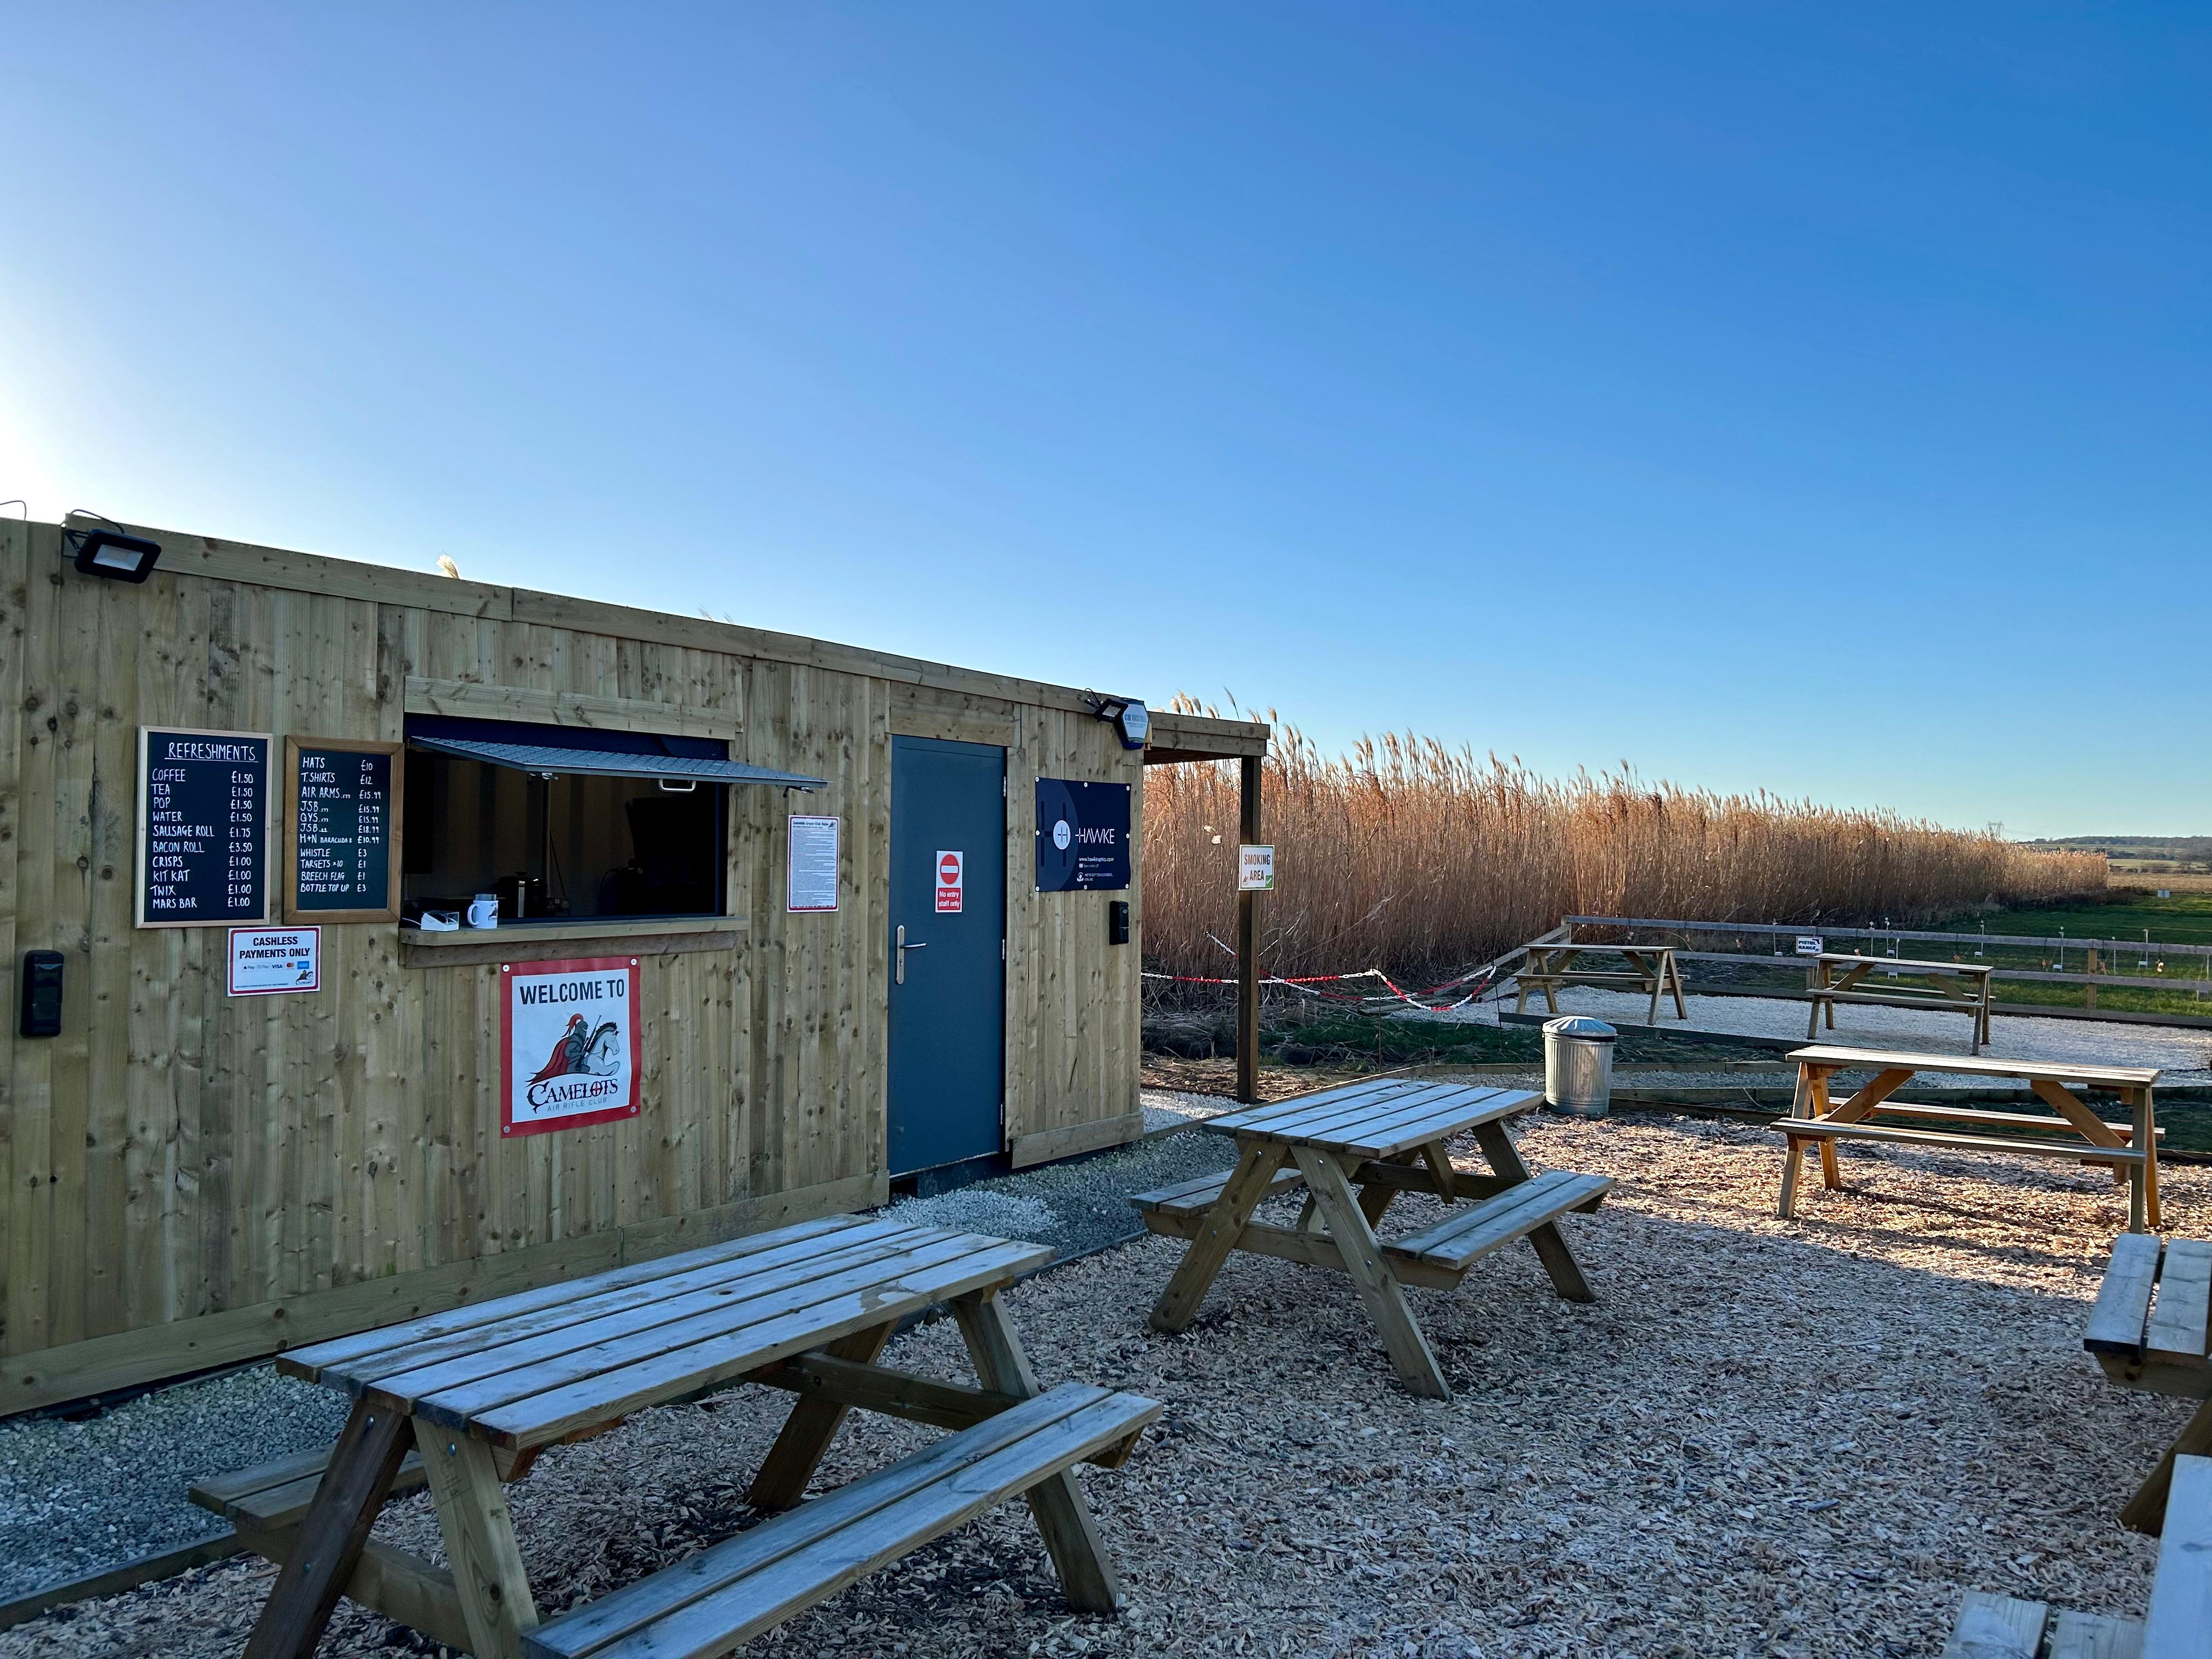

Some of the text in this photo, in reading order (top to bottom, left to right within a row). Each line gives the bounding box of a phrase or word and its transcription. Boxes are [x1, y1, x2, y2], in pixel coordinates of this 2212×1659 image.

[168, 742, 256, 761] REFRESHMENTS
[303, 757, 373, 771] HATS £10
[153, 768, 253, 783] COFFEE £1.50
[301, 772, 373, 785] T.SHIRTS £12
[150, 784, 252, 797] TEA £1.50
[302, 787, 317, 798] AIR
[319, 787, 340, 798] ARMS
[359, 790, 381, 799] £15.99
[154, 797, 252, 809] POP £1.50
[301, 801, 318, 812] JSB
[359, 804, 379, 814] £15.99
[153, 812, 252, 822] WATER £1.50
[301, 813, 318, 822] QYS
[153, 825, 250, 838] SAUSAGE ROLL £1.75
[300, 823, 318, 832] JSB
[358, 825, 379, 833] £18.99
[300, 834, 317, 843] H+N
[1075, 828, 1115, 844] HAWKE
[154, 842, 252, 853] BACON ROLL £3.50
[301, 848, 366, 857] WHISTLE £3
[153, 856, 251, 867] CRISPS £1.00
[301, 860, 330, 868] TARGETS
[1244, 854, 1270, 865] SMOKING
[154, 870, 251, 882] KIT KAT £1.00
[301, 872, 328, 881] BREECH
[330, 872, 345, 881] FLAG
[1250, 870, 1264, 881] AREA
[150, 884, 251, 896] TWIX £1.00
[301, 884, 326, 892] BOTTLE
[329, 884, 339, 892] TOP
[153, 897, 250, 909] MARS BAR £1.00
[253, 936, 298, 946] CASHLESS
[239, 948, 310, 959] PAYMENTS ONLY
[520, 979, 624, 1005] WELCOME TO
[563, 1101, 585, 1109] RIFLE
